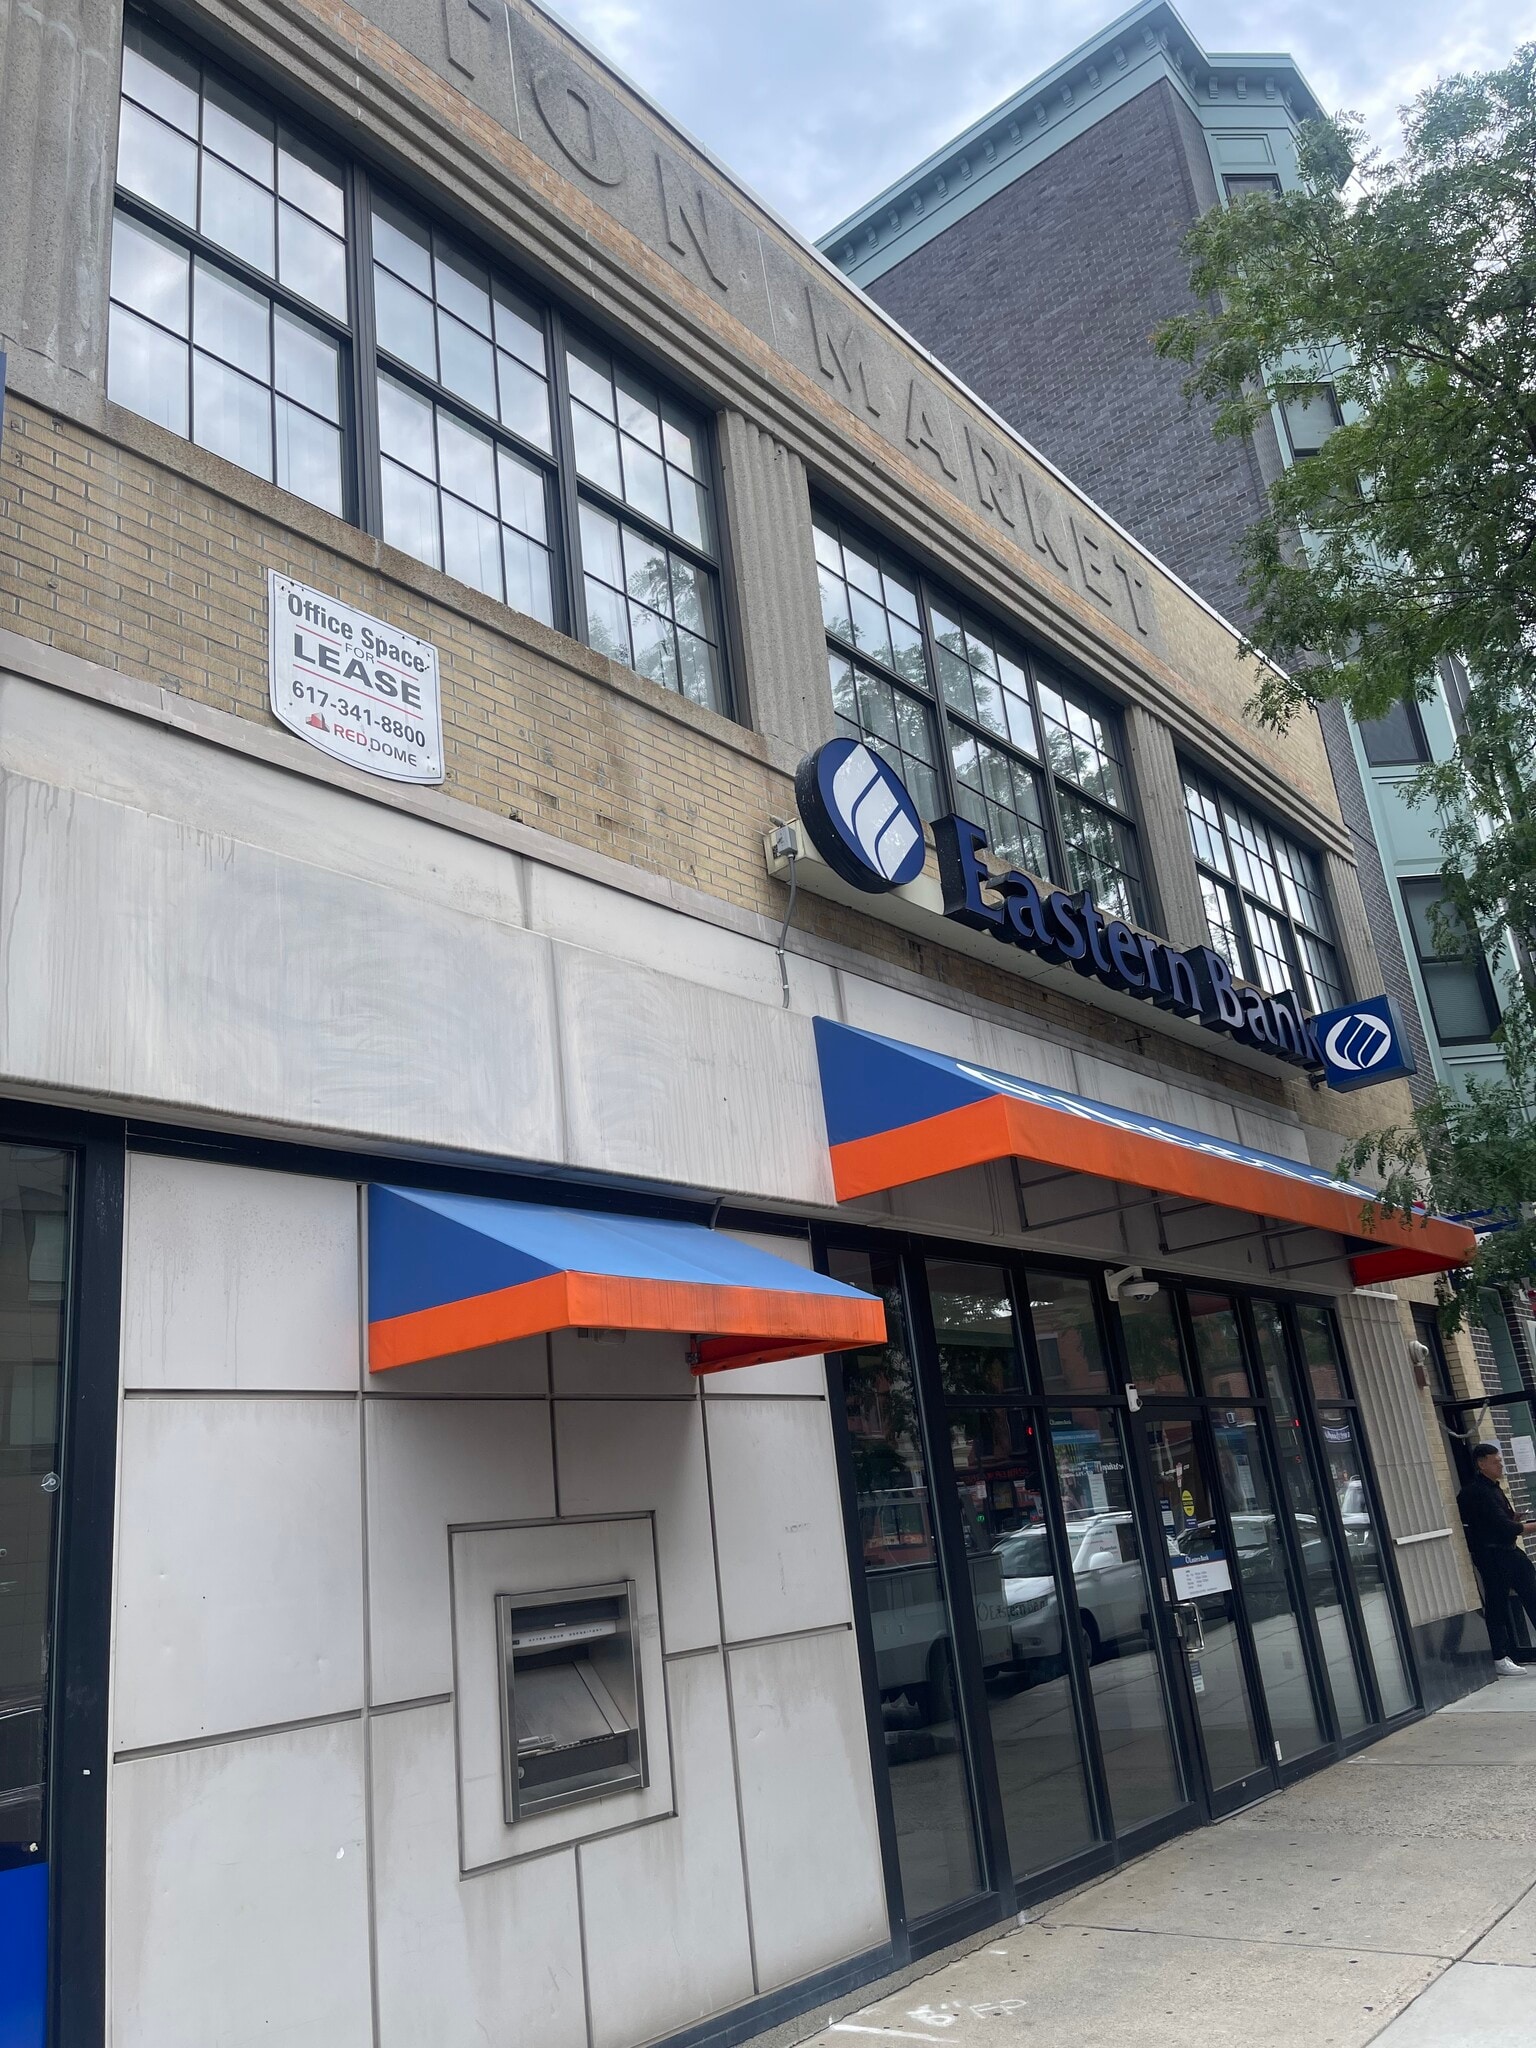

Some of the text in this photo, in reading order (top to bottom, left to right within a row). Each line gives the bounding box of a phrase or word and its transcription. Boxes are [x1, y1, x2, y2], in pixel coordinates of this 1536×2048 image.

[804, 284, 1149, 635] MARKET
[288, 593, 424, 673] Office Space
[294, 633, 422, 710] LEASE
[345, 642, 375, 664] FOR
[292, 680, 425, 748] 617-341-8800
[940, 813, 1327, 1068] Eastern Bank
